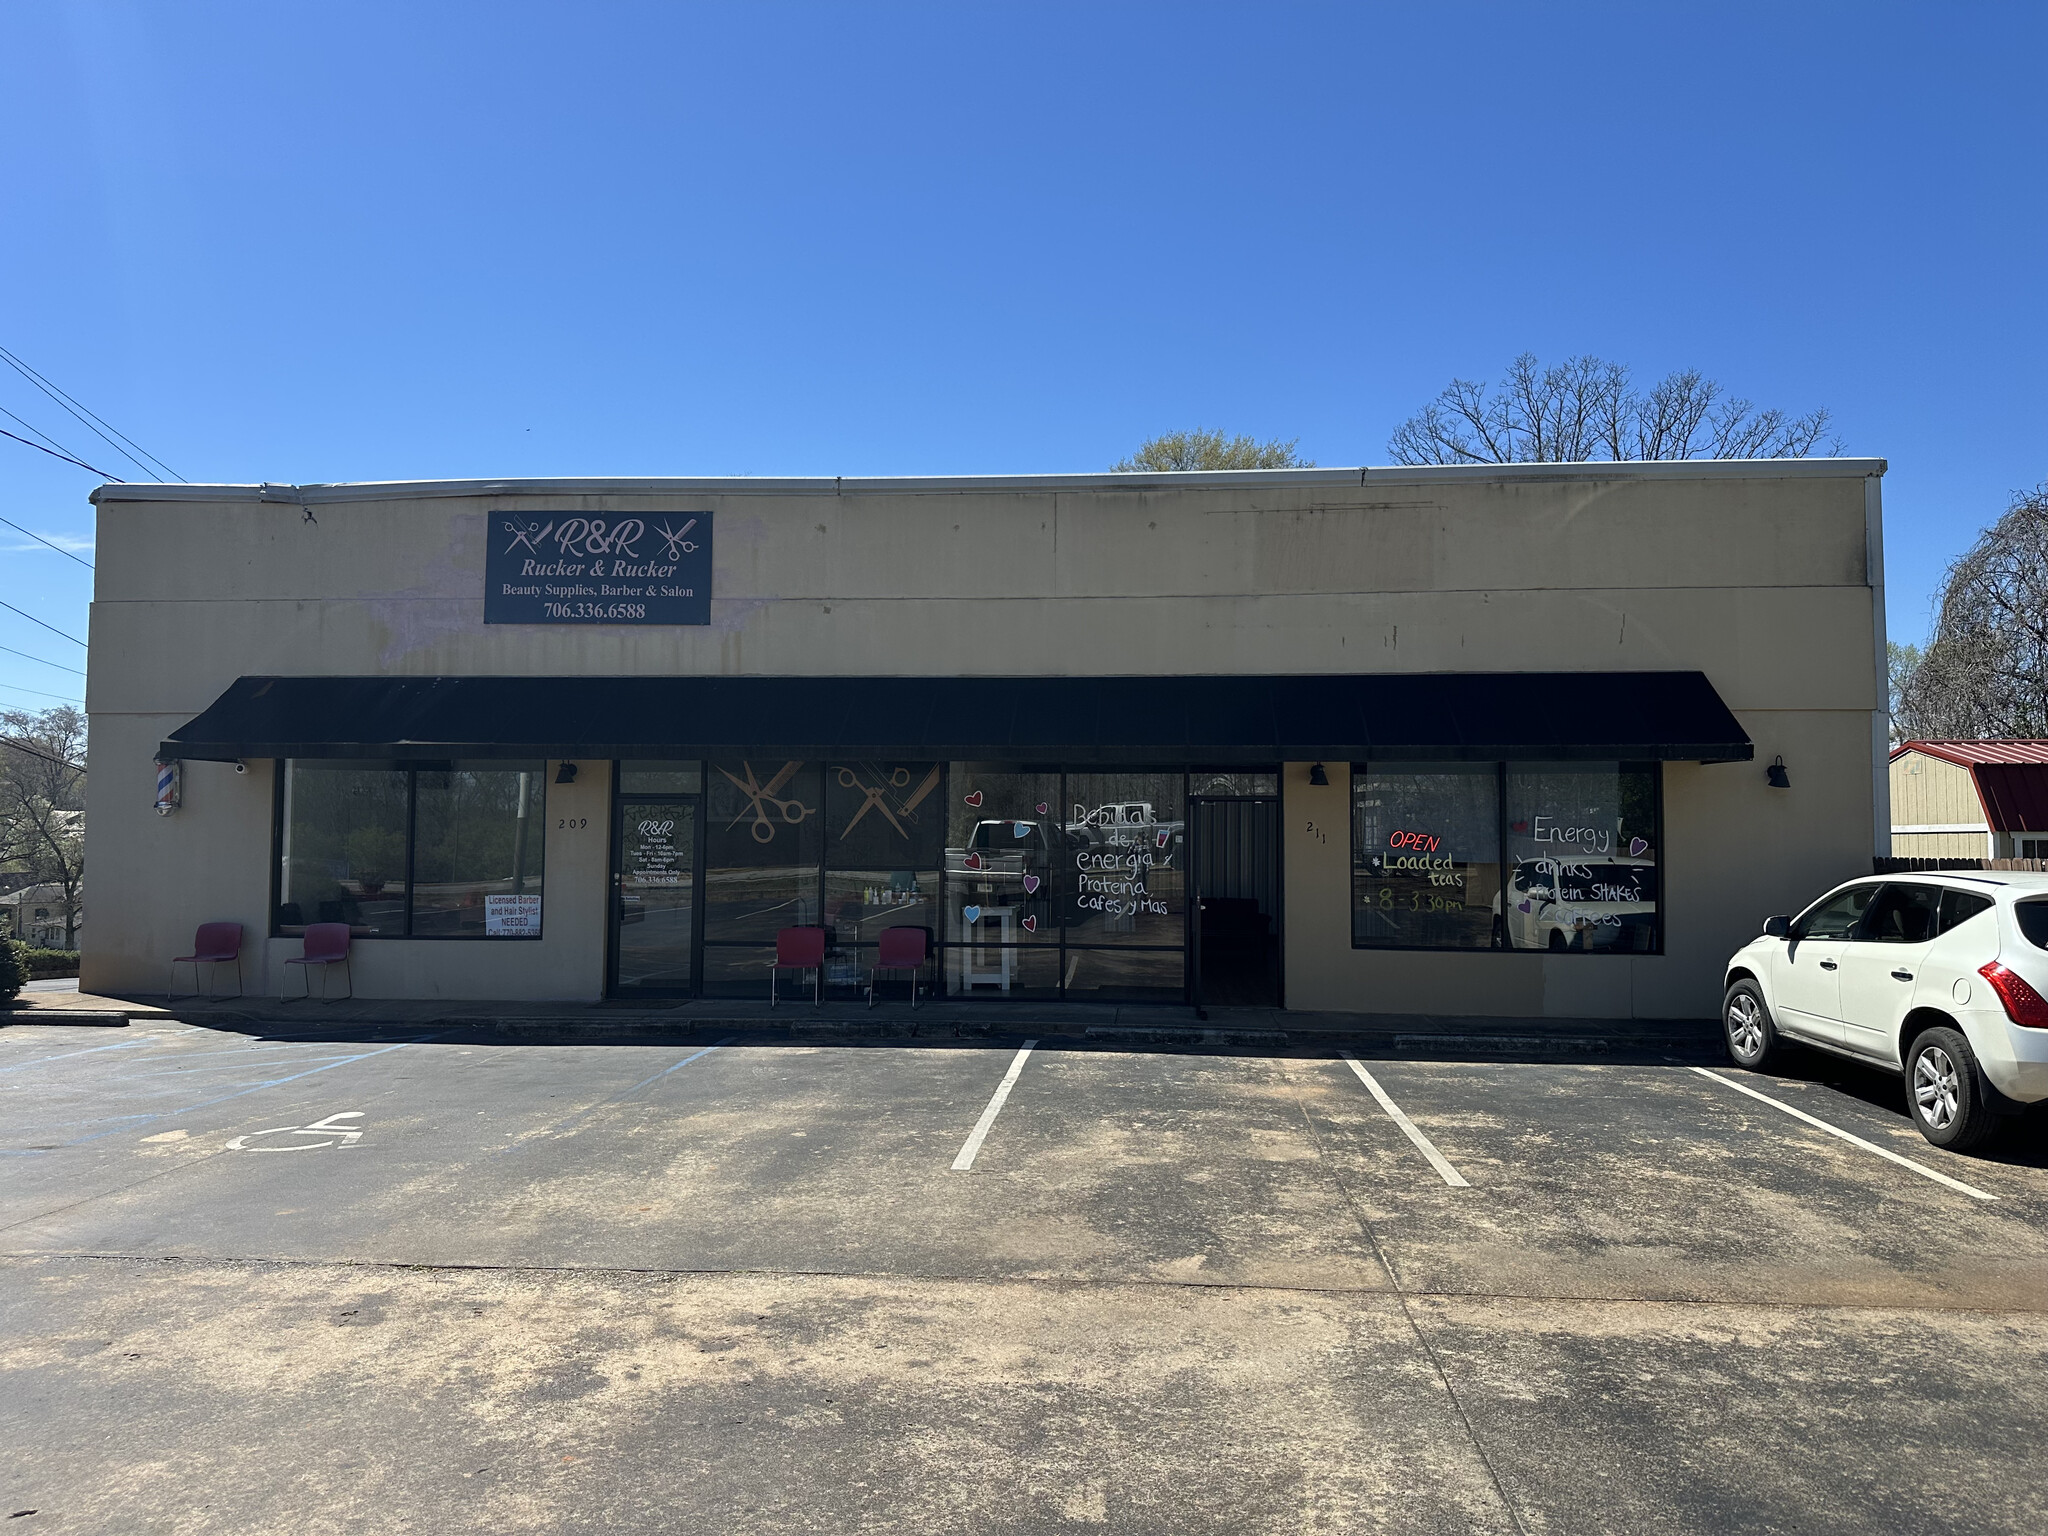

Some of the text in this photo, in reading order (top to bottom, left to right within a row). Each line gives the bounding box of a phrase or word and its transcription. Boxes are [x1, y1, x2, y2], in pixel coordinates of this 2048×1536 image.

[554, 518, 645, 558] R&R
[520, 559, 677, 578] Rucker & Rucker
[502, 583, 693, 598] Beauty Supplies, Barber & Salon
[543, 602, 645, 619] 706.336.6588
[559, 818, 587, 829] 209
[1073, 801, 1157, 827] Bebidas
[638, 820, 674, 836] R&R
[1108, 827, 1130, 847] de
[1307, 821, 1326, 844] 211
[1534, 816, 1609, 853] Energy
[1390, 830, 1440, 852] OPEN
[1383, 851, 1453, 870] Loaded
[1535, 850, 1593, 879] drinks
[634, 876, 678, 884] 706.336.6588
[1428, 871, 1463, 887] teas
[489, 895, 539, 904] Licensed Barber
[1379, 888, 1394, 911] 8
[1590, 883, 1642, 902] SHAKES
[491, 906, 538, 917] and Hair Stylist
[1128, 900, 1136, 915] y
[501, 918, 528, 926] NEEDED
